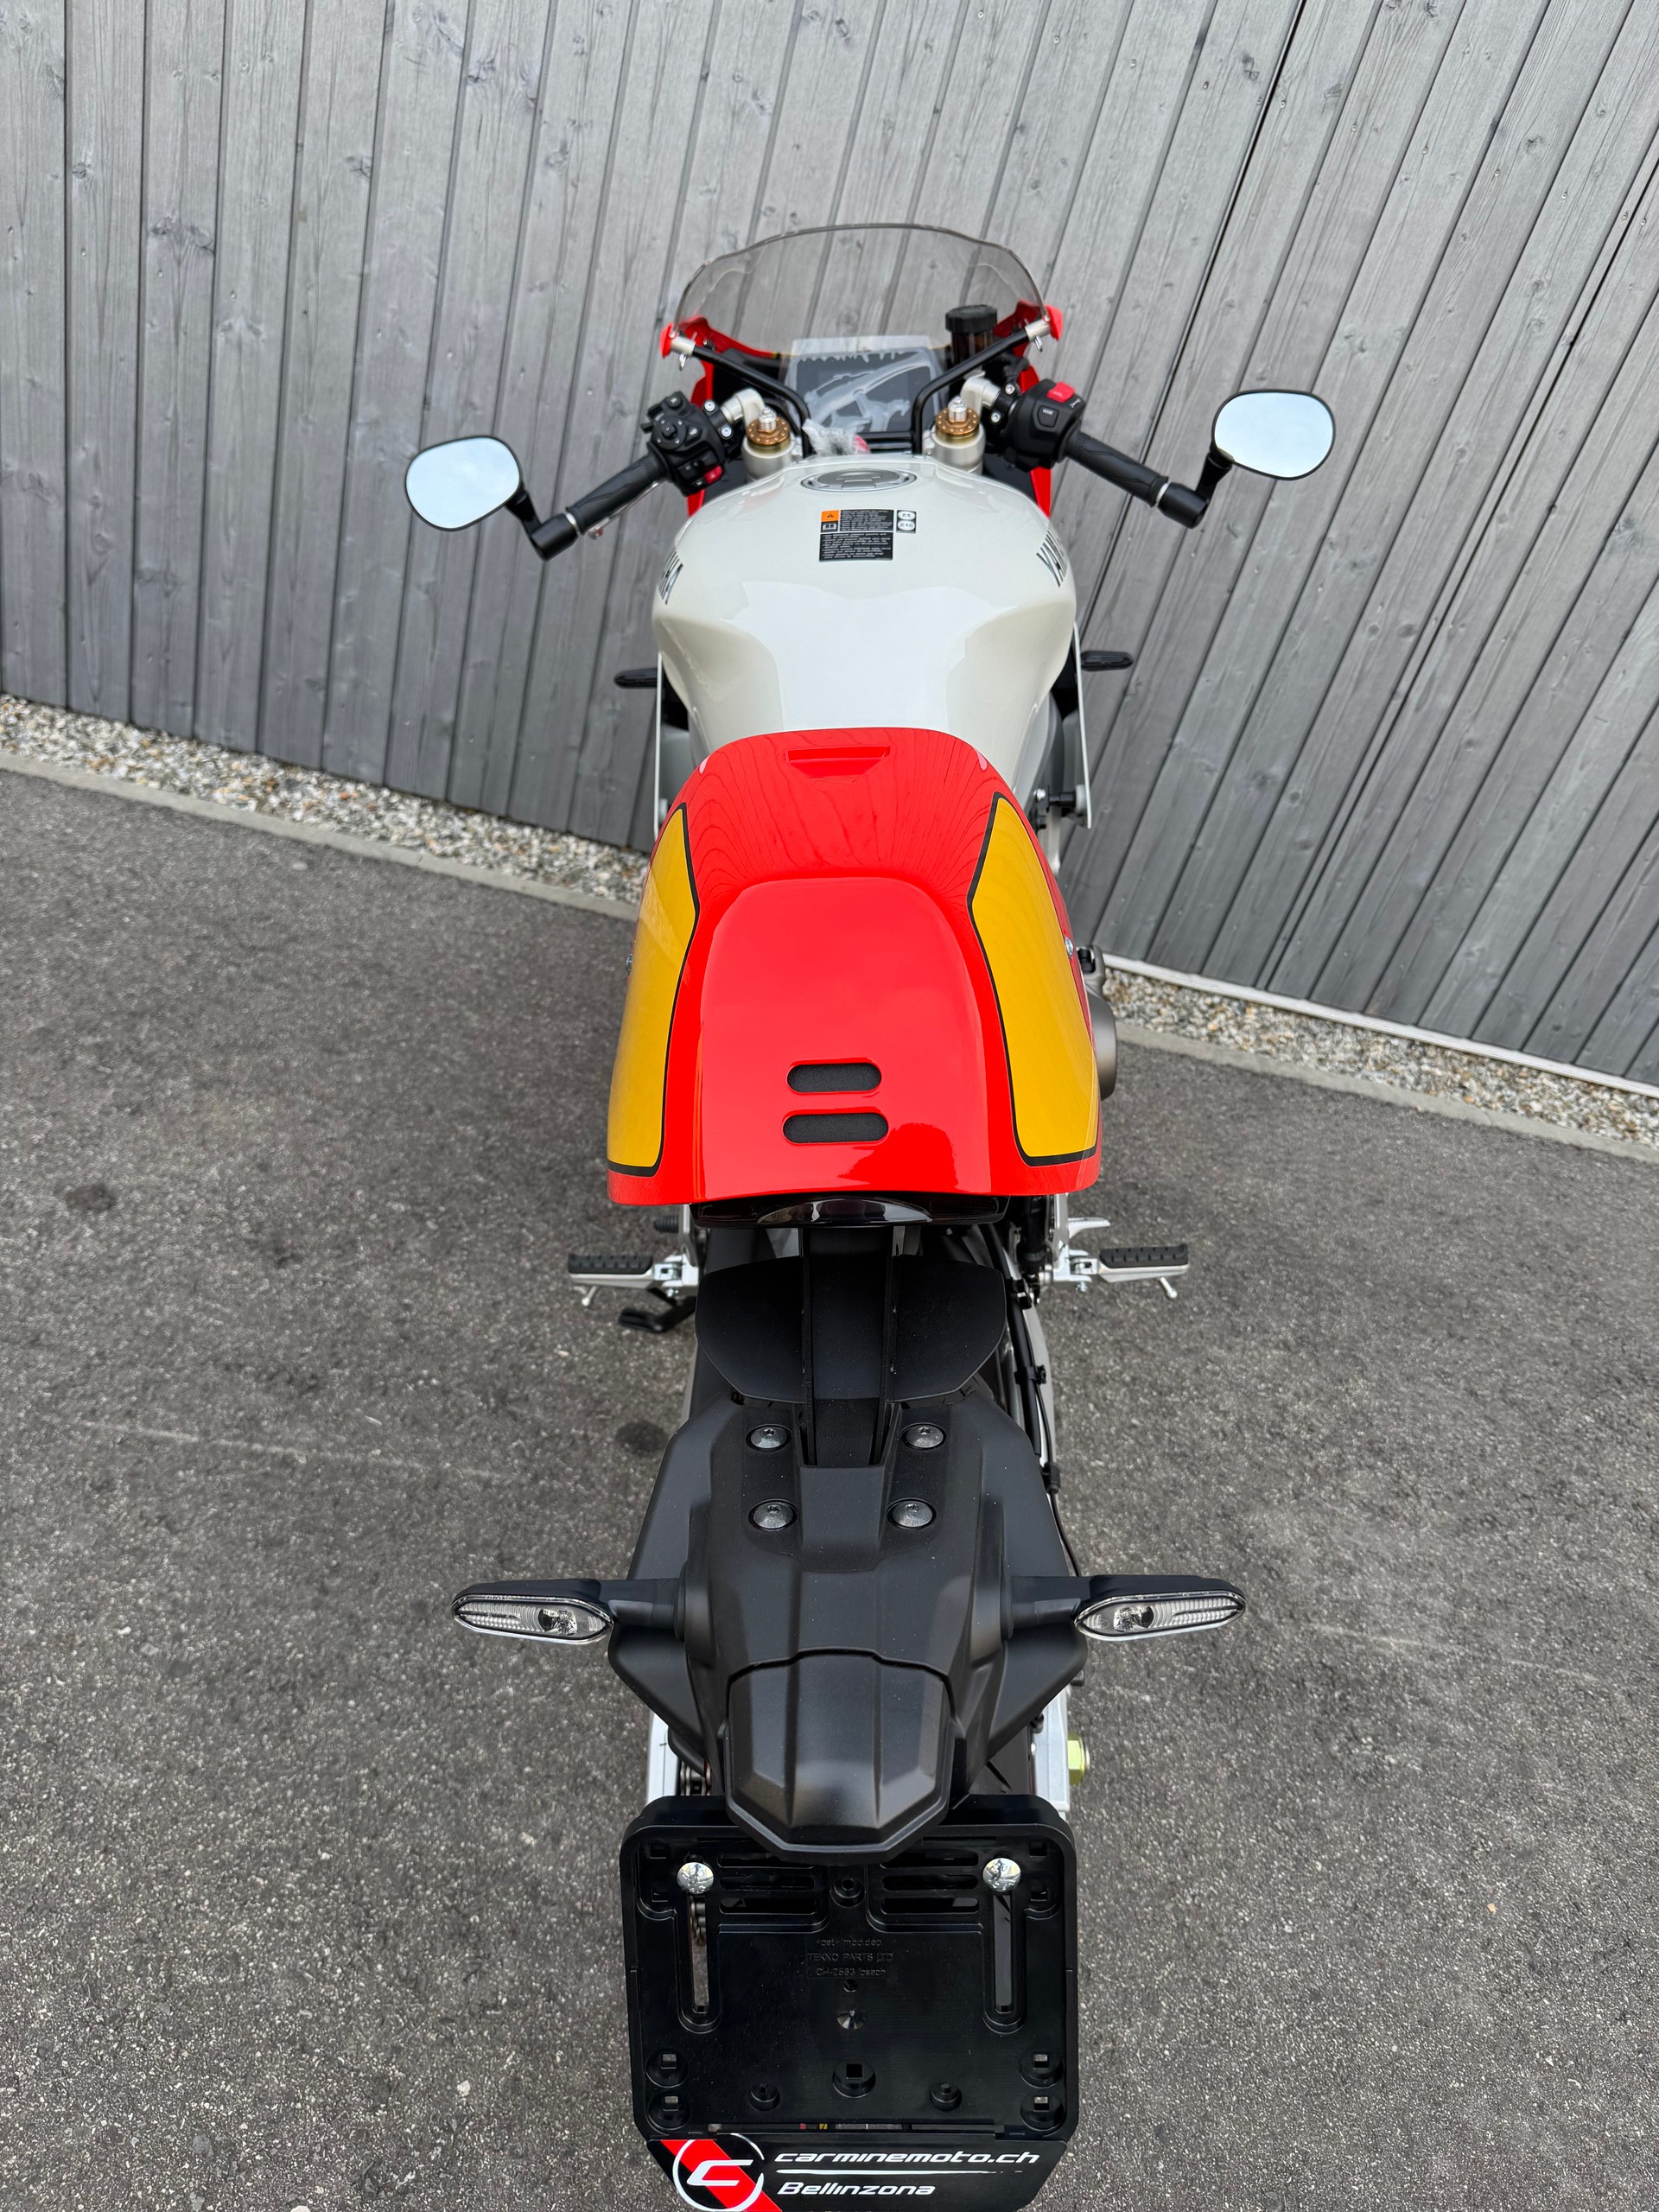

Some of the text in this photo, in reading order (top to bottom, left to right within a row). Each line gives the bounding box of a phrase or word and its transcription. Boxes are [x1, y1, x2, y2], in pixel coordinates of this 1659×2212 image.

[807, 1953, 839, 1961] TEKNO
[842, 1953, 874, 1961] PARTS
[774, 2151, 1039, 2164] carminemoto.ch
[778, 2182, 936, 2196] Bellinzona
